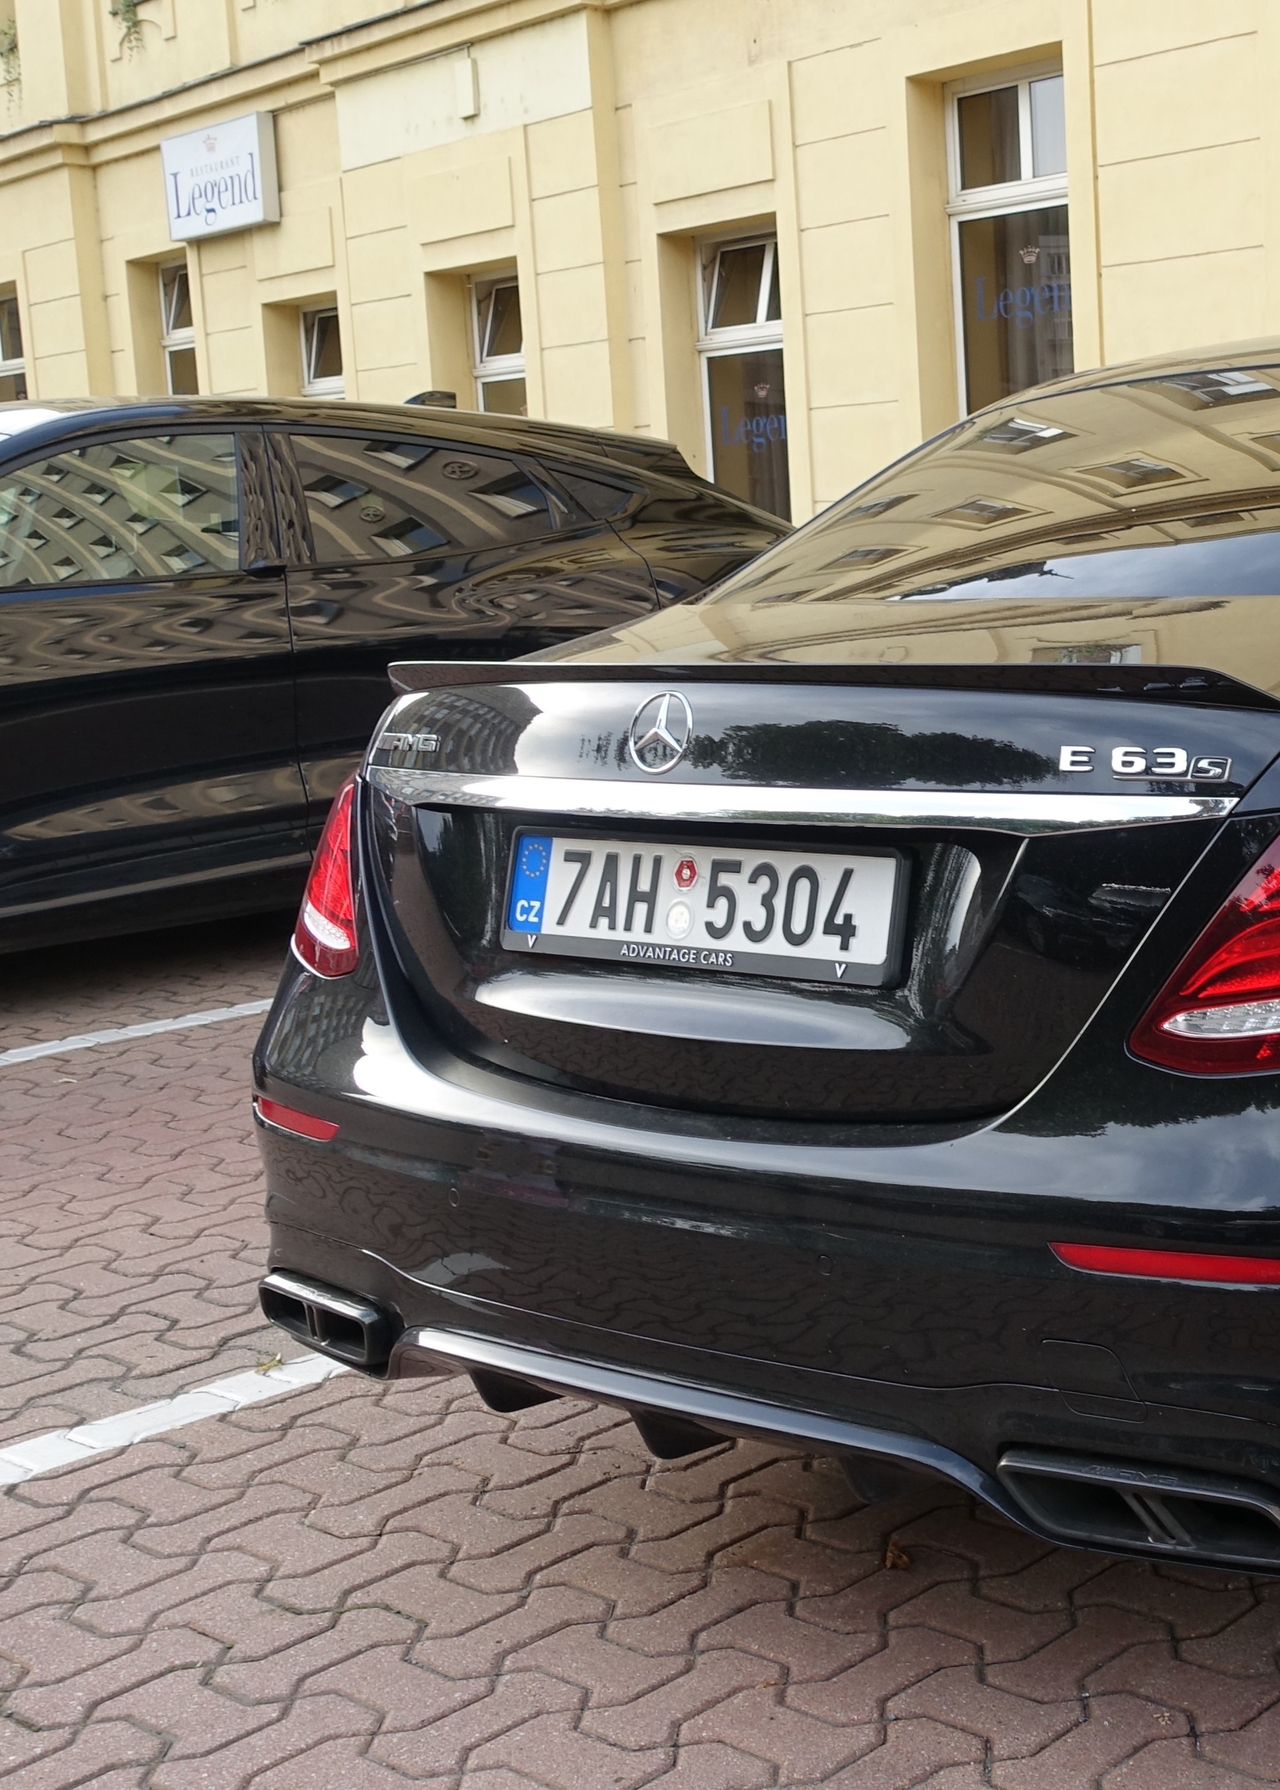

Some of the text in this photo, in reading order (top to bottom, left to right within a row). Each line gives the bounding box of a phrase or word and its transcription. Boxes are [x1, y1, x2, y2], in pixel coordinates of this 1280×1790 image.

[190, 156, 240, 178] RESTAURANT
[169, 152, 259, 226] Legend
[384, 732, 441, 752] AMG
[1059, 746, 1095, 772] E
[515, 899, 540, 923] CZ
[556, 849, 856, 951] 7AH 5304
[620, 944, 733, 967] ADVANTAGE CARS
